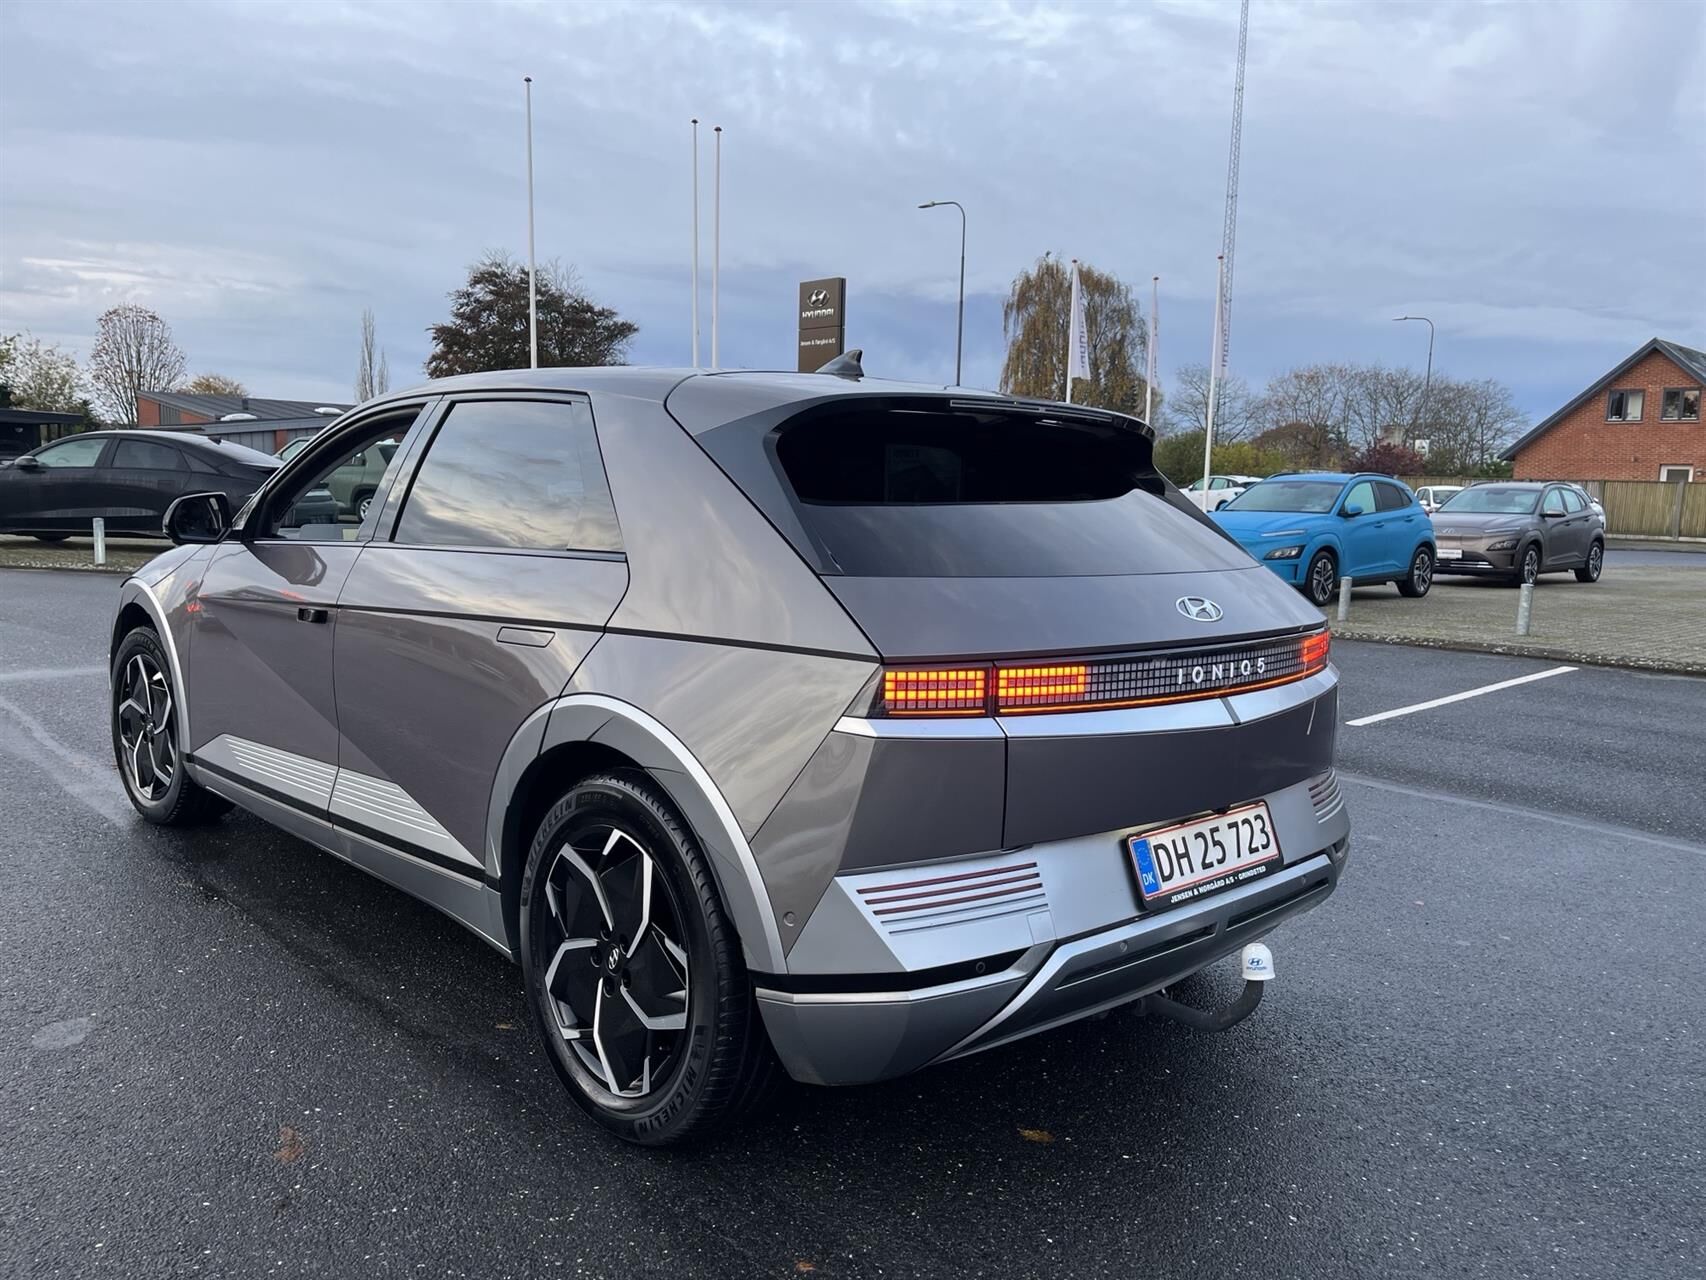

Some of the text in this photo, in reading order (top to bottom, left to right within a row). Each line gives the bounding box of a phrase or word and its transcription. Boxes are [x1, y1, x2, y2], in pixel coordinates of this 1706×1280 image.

[1177, 657, 1266, 685] IONIQ 5
[1152, 813, 1271, 883] DH 25 723
[1142, 873, 1156, 886] DK
[1170, 890, 1193, 903] JENSEN
[1238, 865, 1267, 880] GRINDSTED
[638, 1065, 698, 1133] MICHELIN
